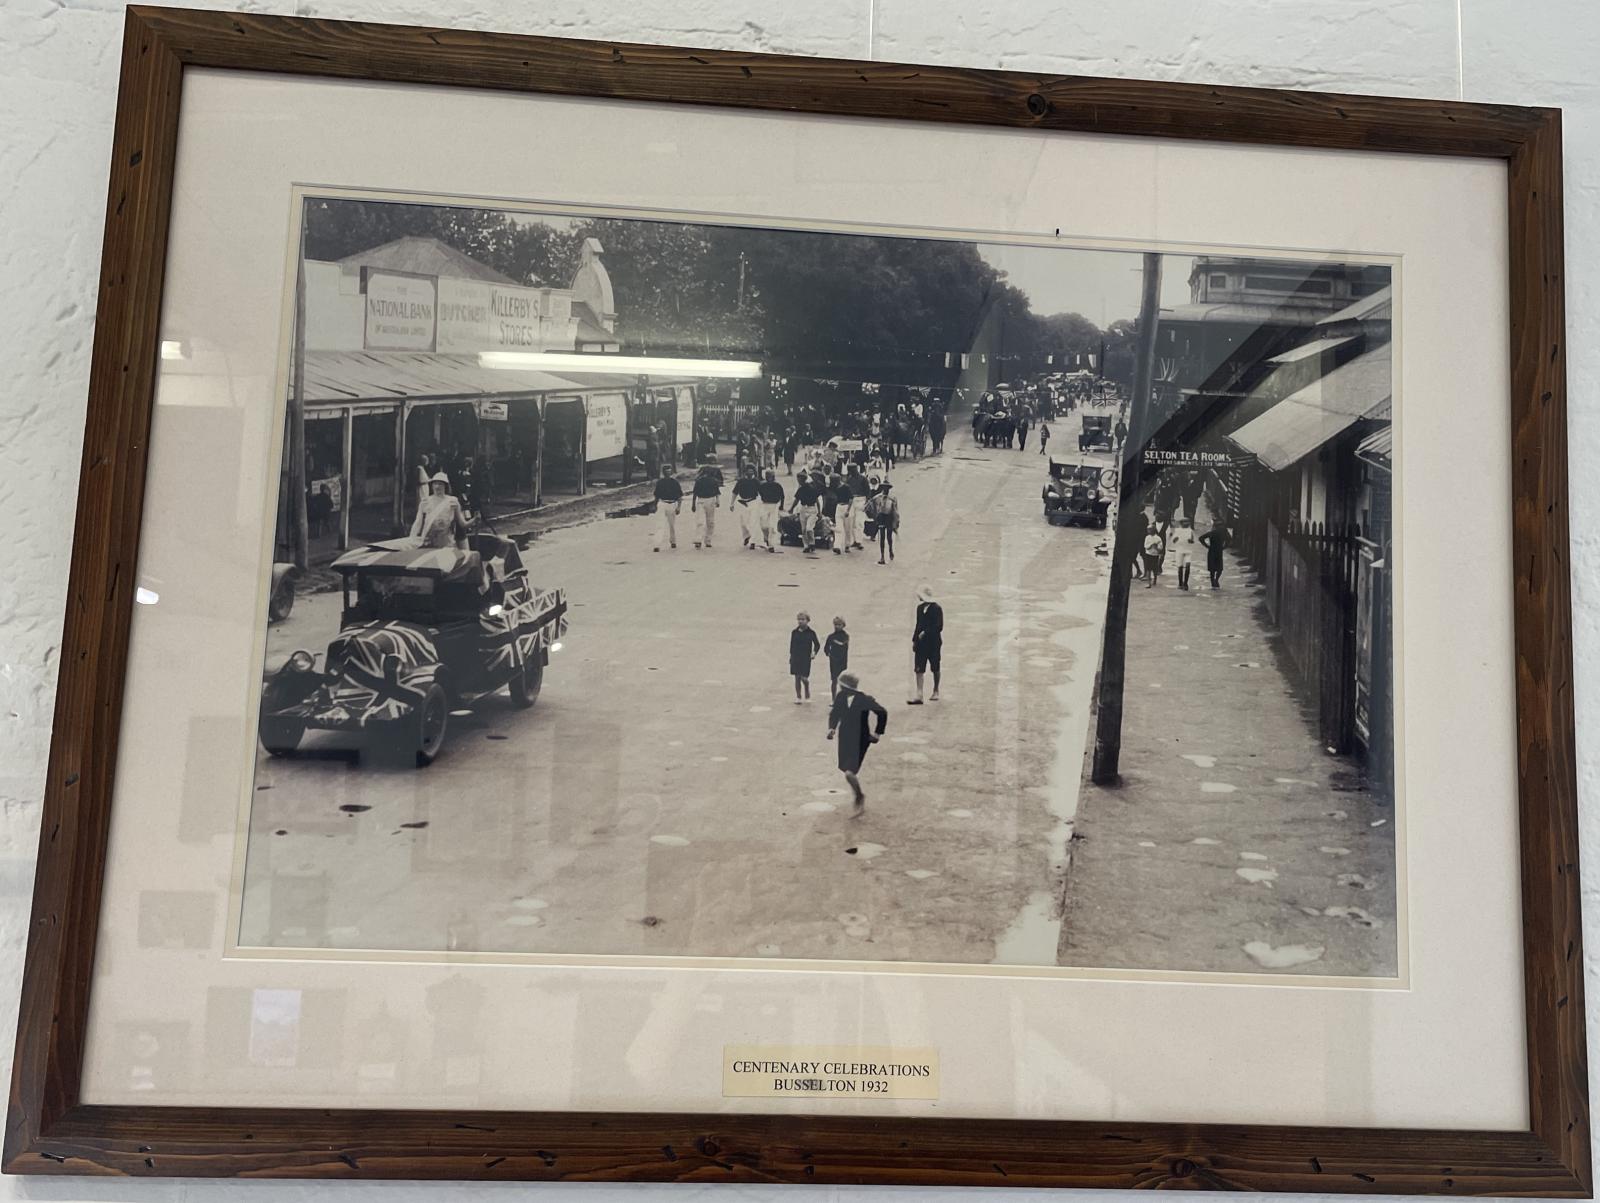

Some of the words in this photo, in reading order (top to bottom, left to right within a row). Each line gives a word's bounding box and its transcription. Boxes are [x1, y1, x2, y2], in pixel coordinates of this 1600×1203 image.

[370, 298, 409, 319] NATIONAL
[410, 302, 432, 320] BANK
[499, 320, 533, 346] STORES
[1144, 450, 1177, 460] SELTON
[1180, 451, 1199, 461] TEA
[1201, 452, 1232, 462] ROOMS
[733, 1060, 820, 1074] CENTENARY
[823, 1062, 930, 1077] CELEBRATIONS
[774, 1078, 856, 1092] BUSSELTON
[861, 1080, 889, 1093] 1932
